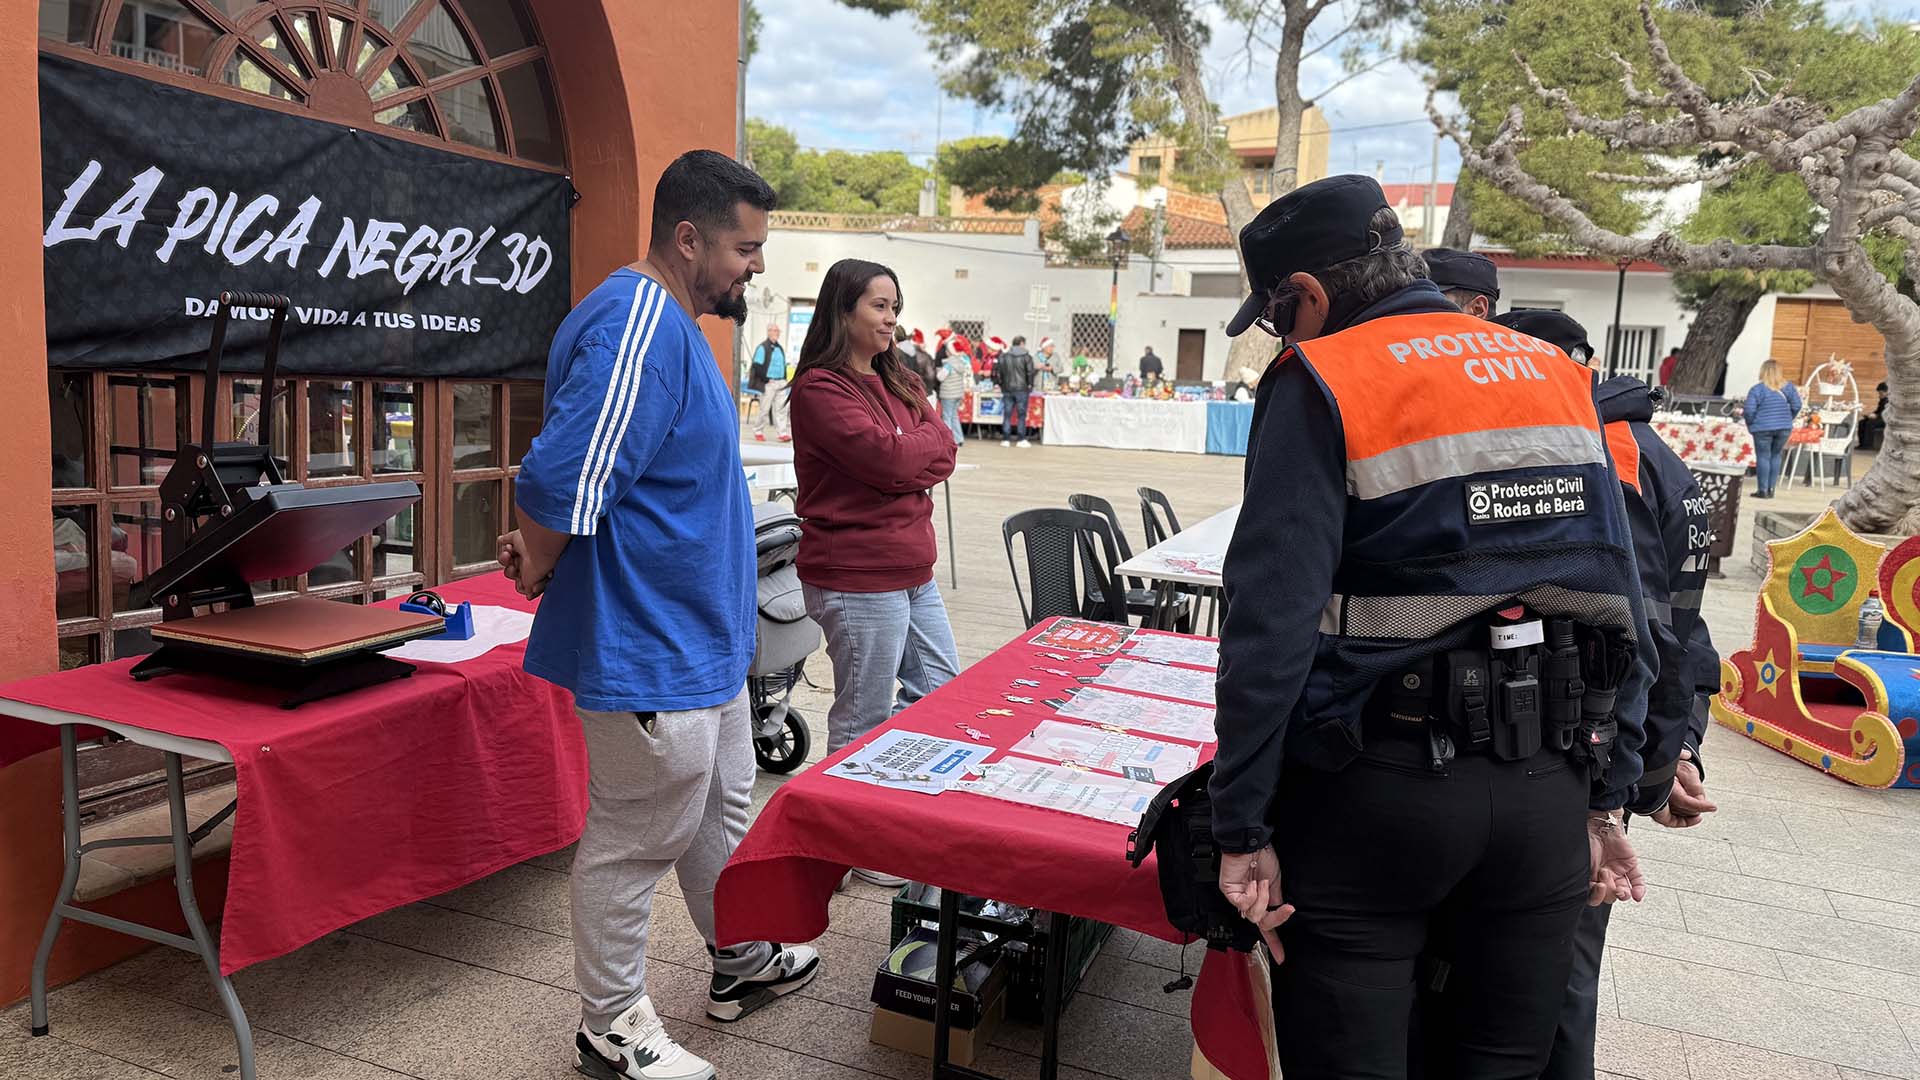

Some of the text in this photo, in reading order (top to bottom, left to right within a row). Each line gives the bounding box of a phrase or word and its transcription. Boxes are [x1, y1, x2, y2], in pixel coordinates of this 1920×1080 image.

[43, 159, 553, 295] LA PICA NEGRA_3D
[295, 306, 349, 325] VIDA
[352, 311, 367, 326] A
[373, 311, 416, 330] TUS
[420, 314, 482, 334] IDEAS
[1463, 356, 1546, 385] CIVIL
[1491, 477, 1584, 500] Protecció Civil
[1493, 496, 1585, 518] Roda de Berà
[1682, 497, 1707, 516] PRO
[895, 989, 932, 1004] FEED YOUR
